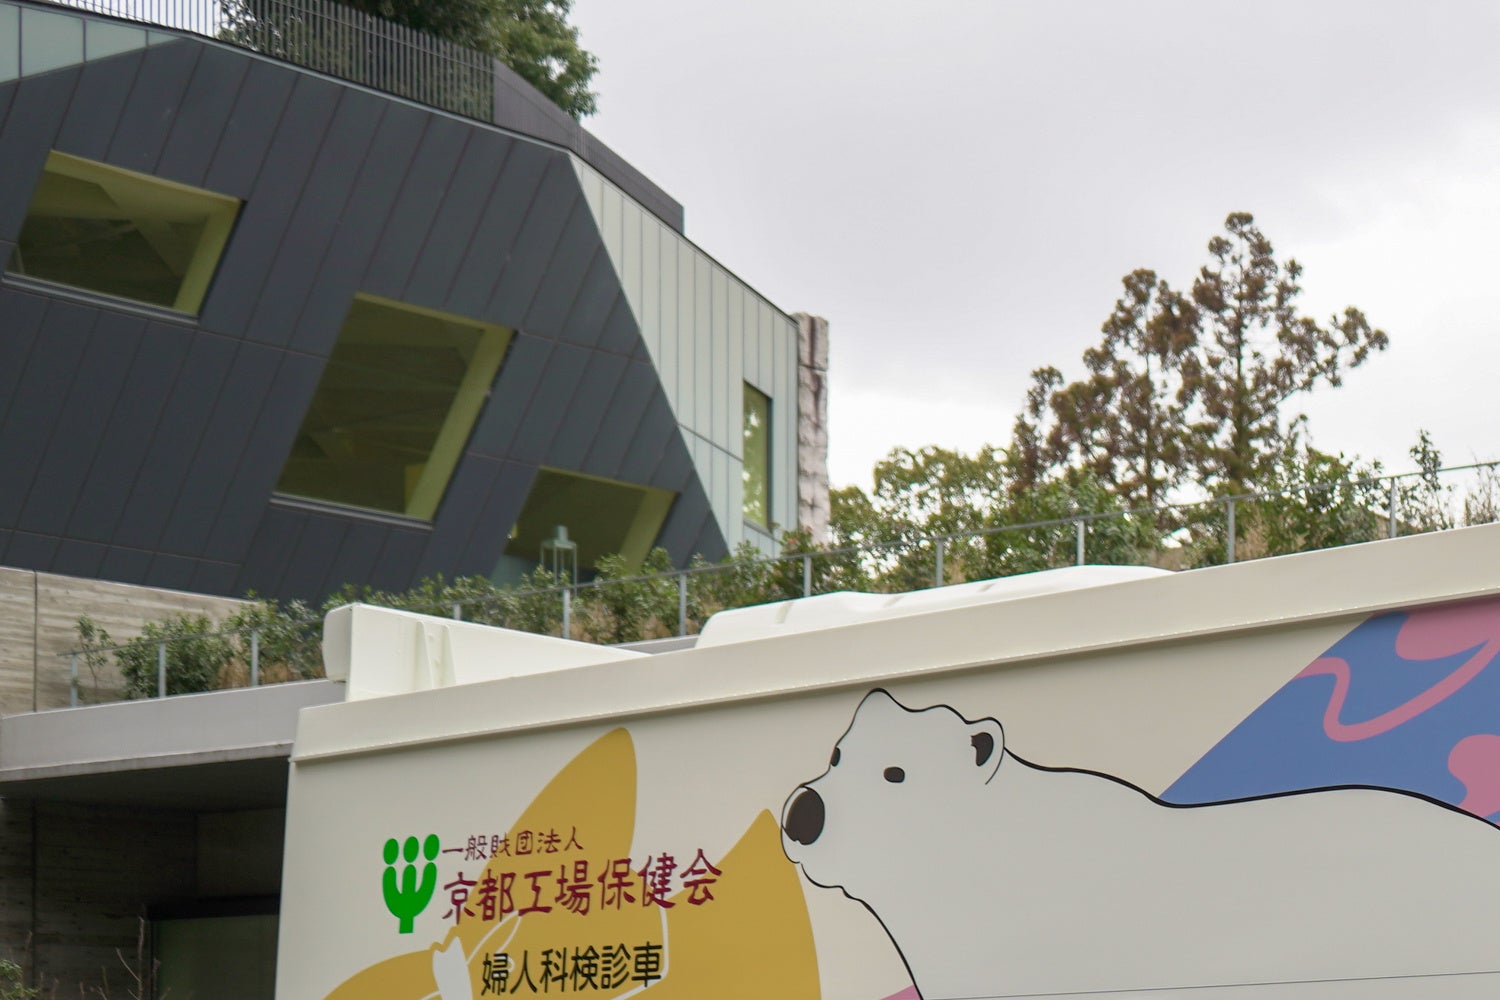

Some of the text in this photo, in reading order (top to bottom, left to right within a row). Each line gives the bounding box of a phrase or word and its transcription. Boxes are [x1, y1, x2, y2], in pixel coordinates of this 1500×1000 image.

[442, 826, 584, 861] 一般財団法人
[442, 848, 723, 925] 京都工場保健会
[480, 941, 663, 996] 婦人科検診車
